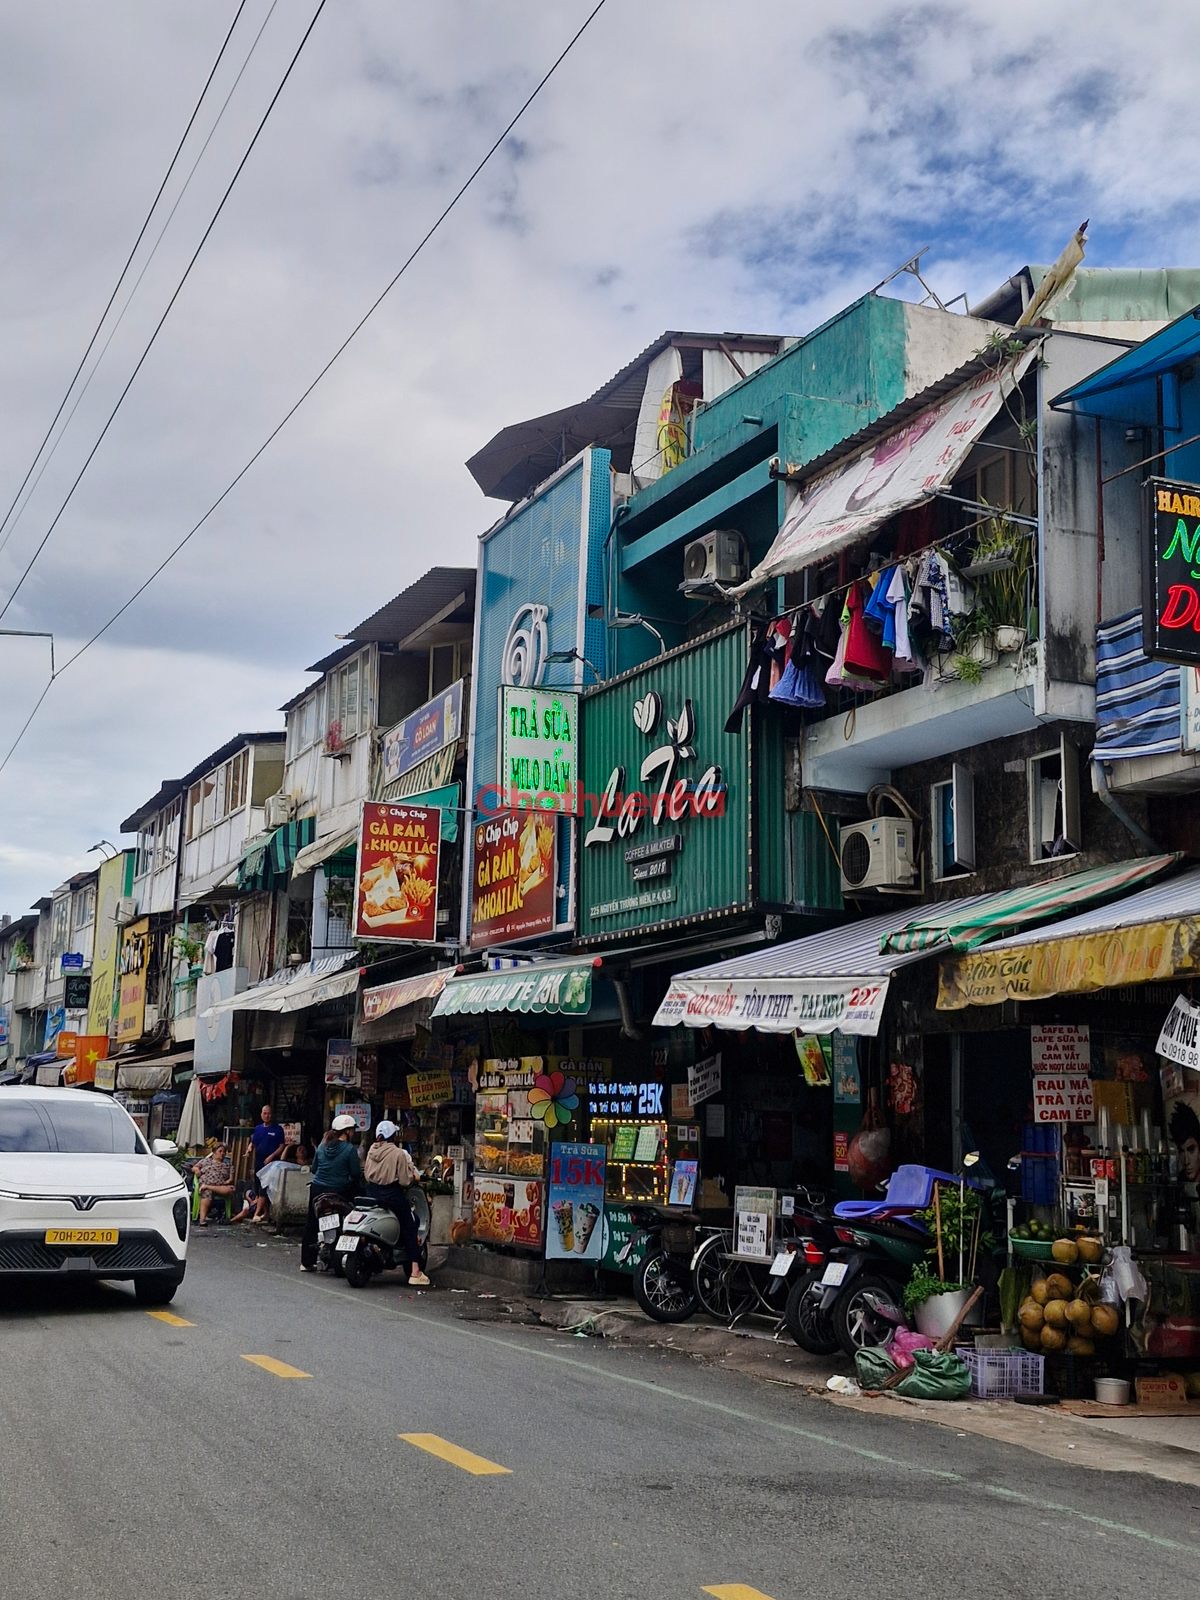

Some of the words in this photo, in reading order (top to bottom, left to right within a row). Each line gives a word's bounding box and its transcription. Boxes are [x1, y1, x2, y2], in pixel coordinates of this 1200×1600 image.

[1160, 584, 1200, 629] D
[510, 757, 541, 792] MILO
[584, 765, 643, 848] La
[369, 819, 389, 836] GÀ
[392, 820, 425, 838] RÁN
[370, 839, 412, 853] KHOAI
[414, 835, 438, 855] LẮC
[624, 846, 645, 861] COFFEE
[645, 846, 650, 855] &
[650, 838, 675, 852] MILKTEA
[478, 850, 491, 888] GÀ
[491, 842, 515, 884] RÁN
[633, 867, 648, 880] Since
[649, 860, 667, 876] 2018
[477, 885, 506, 922] KHOAI
[506, 867, 524, 913] LẮC
[590, 907, 599, 917] 225
[1000, 954, 1033, 978] Tóc
[1100, 937, 1164, 977] Dung
[534, 973, 567, 1005] 25K
[1005, 979, 1030, 994] Nữ
[740, 987, 766, 1018] TÔM
[765, 994, 793, 1024] THỊT
[799, 994, 819, 1020] TAI
[819, 993, 845, 1019] HEO
[848, 987, 882, 1007] 227
[1041, 1026, 1064, 1034] CAFE
[1056, 1034, 1075, 1043] SỮA
[1077, 1034, 1089, 1043] ĐÁ
[1046, 1043, 1059, 1051] ĐÁ
[1064, 1051, 1081, 1060] VẮT
[1168, 1043, 1187, 1062] 0918
[560, 1059, 575, 1071] GÀ
[579, 1058, 603, 1072] RÁN
[1049, 1062, 1065, 1072] NGỌT
[1065, 1061, 1076, 1071] CÁC
[416, 1073, 427, 1082] Có
[1037, 1080, 1066, 1091] RAU
[1069, 1077, 1090, 1090] MÁ
[618, 1081, 638, 1096] Topping
[638, 1083, 664, 1115] 25K
[1035, 1092, 1065, 1106] TRÀ
[1067, 1091, 1093, 1105] TẮC
[1039, 1109, 1071, 1121] CAM
[1075, 1107, 1092, 1120] ÉP
[560, 1145, 579, 1155] Trà
[580, 1145, 599, 1156] Sữa
[551, 1158, 605, 1186] 15K
[481, 1191, 506, 1204] COMBO
[52, 1231, 113, 1242] 70H-202.10
